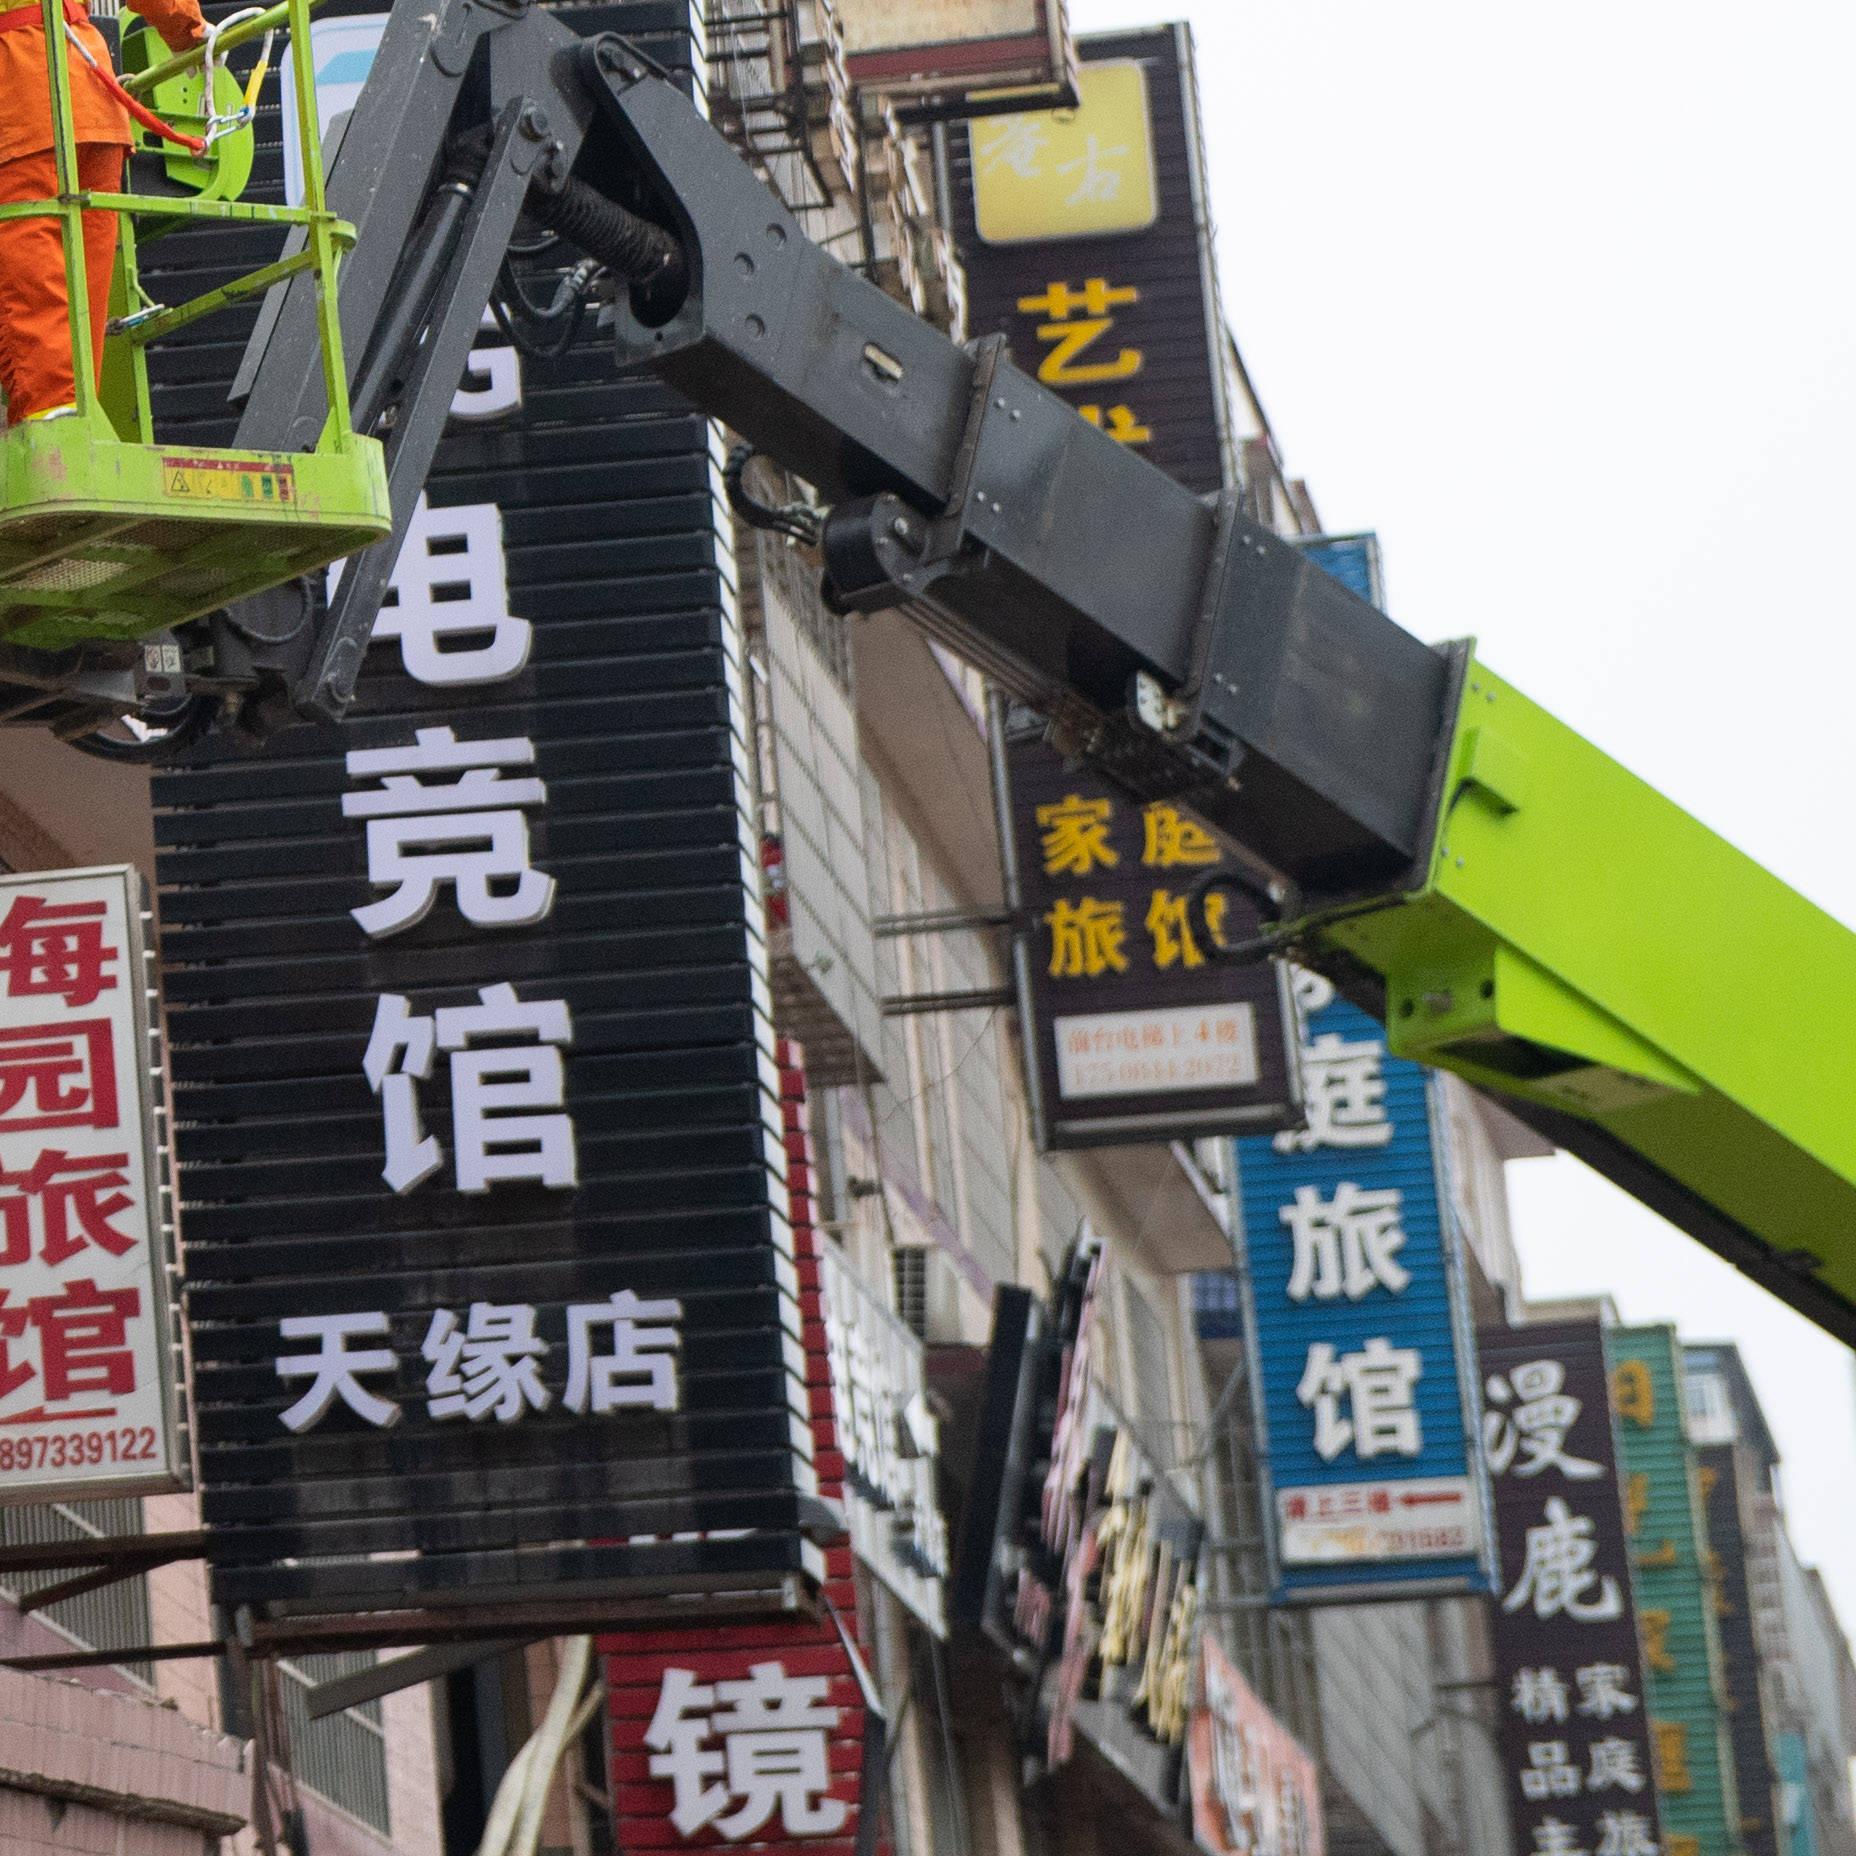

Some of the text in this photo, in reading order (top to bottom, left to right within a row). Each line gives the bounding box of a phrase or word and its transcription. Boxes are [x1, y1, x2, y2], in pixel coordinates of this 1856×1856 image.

[326, 299, 580, 1196] 电竞馆
[276, 1290, 685, 1434] 天缘店
[1483, 1358, 1622, 1622] 漫鹿
[642, 1660, 855, 1841] 镜
